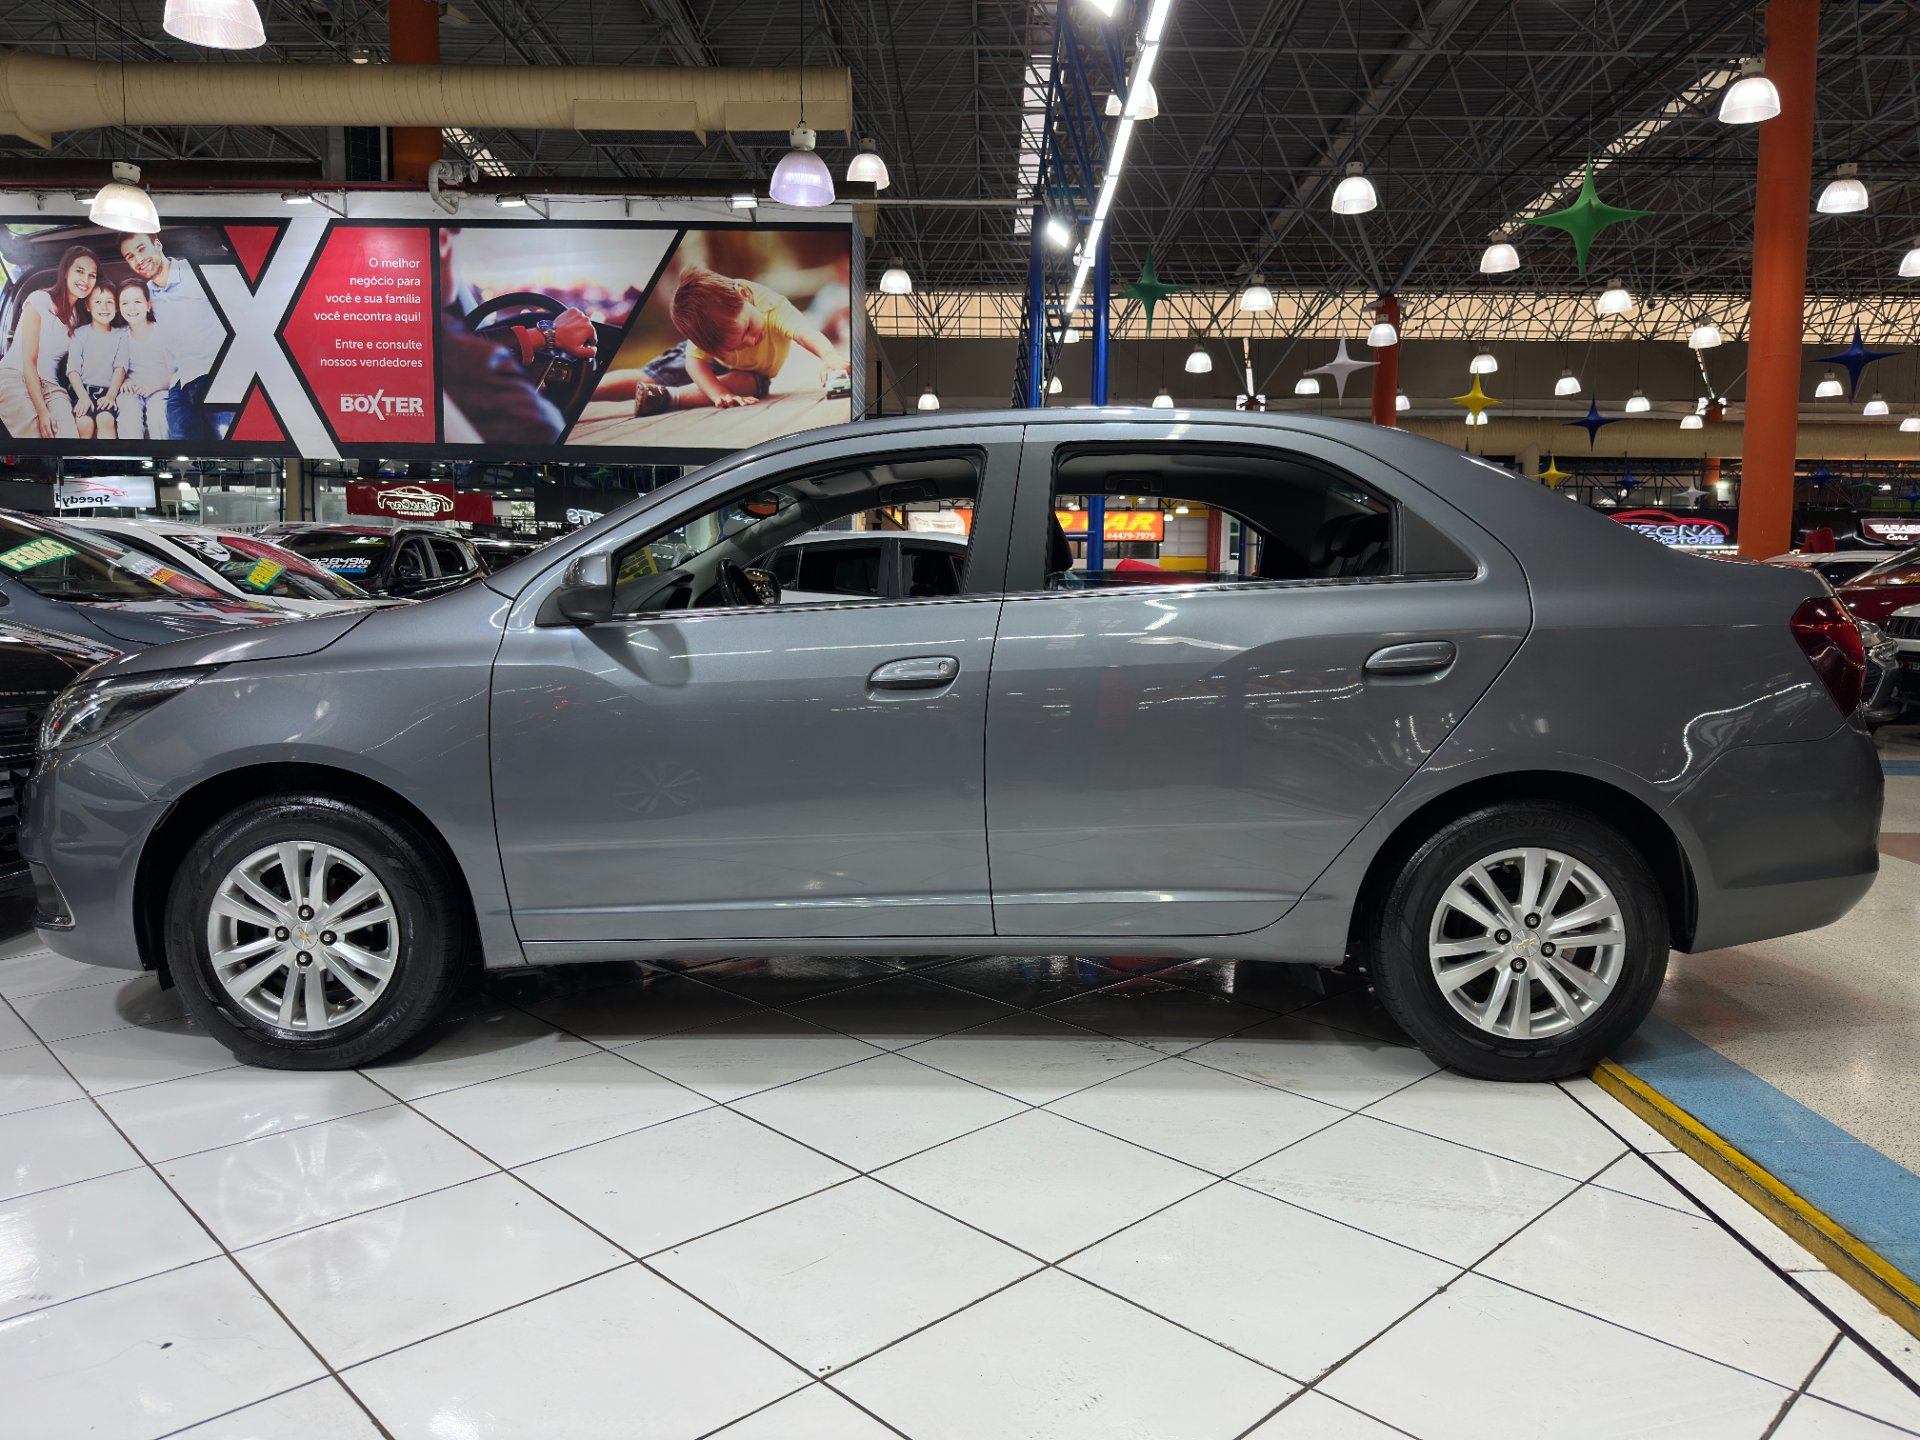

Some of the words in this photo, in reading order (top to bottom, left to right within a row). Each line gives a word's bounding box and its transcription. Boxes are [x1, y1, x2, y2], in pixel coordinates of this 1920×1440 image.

[368, 257, 379, 268] O
[381, 257, 420, 269] melhor
[349, 275, 394, 288] negócio
[397, 278, 421, 288] para
[325, 293, 352, 304] você
[354, 295, 361, 303] e
[363, 296, 382, 304] sua
[385, 293, 421, 304] família
[314, 311, 340, 321] você
[343, 312, 392, 322] encontra
[394, 311, 421, 323] aqui!
[335, 339, 364, 349] Entre
[366, 341, 373, 349] e
[375, 339, 423, 350] consulte
[320, 357, 357, 367] nossos
[359, 357, 423, 368] vendedores
[340, 389, 424, 421] BOXTER
[1111, 532, 1157, 540] 4479-7979
